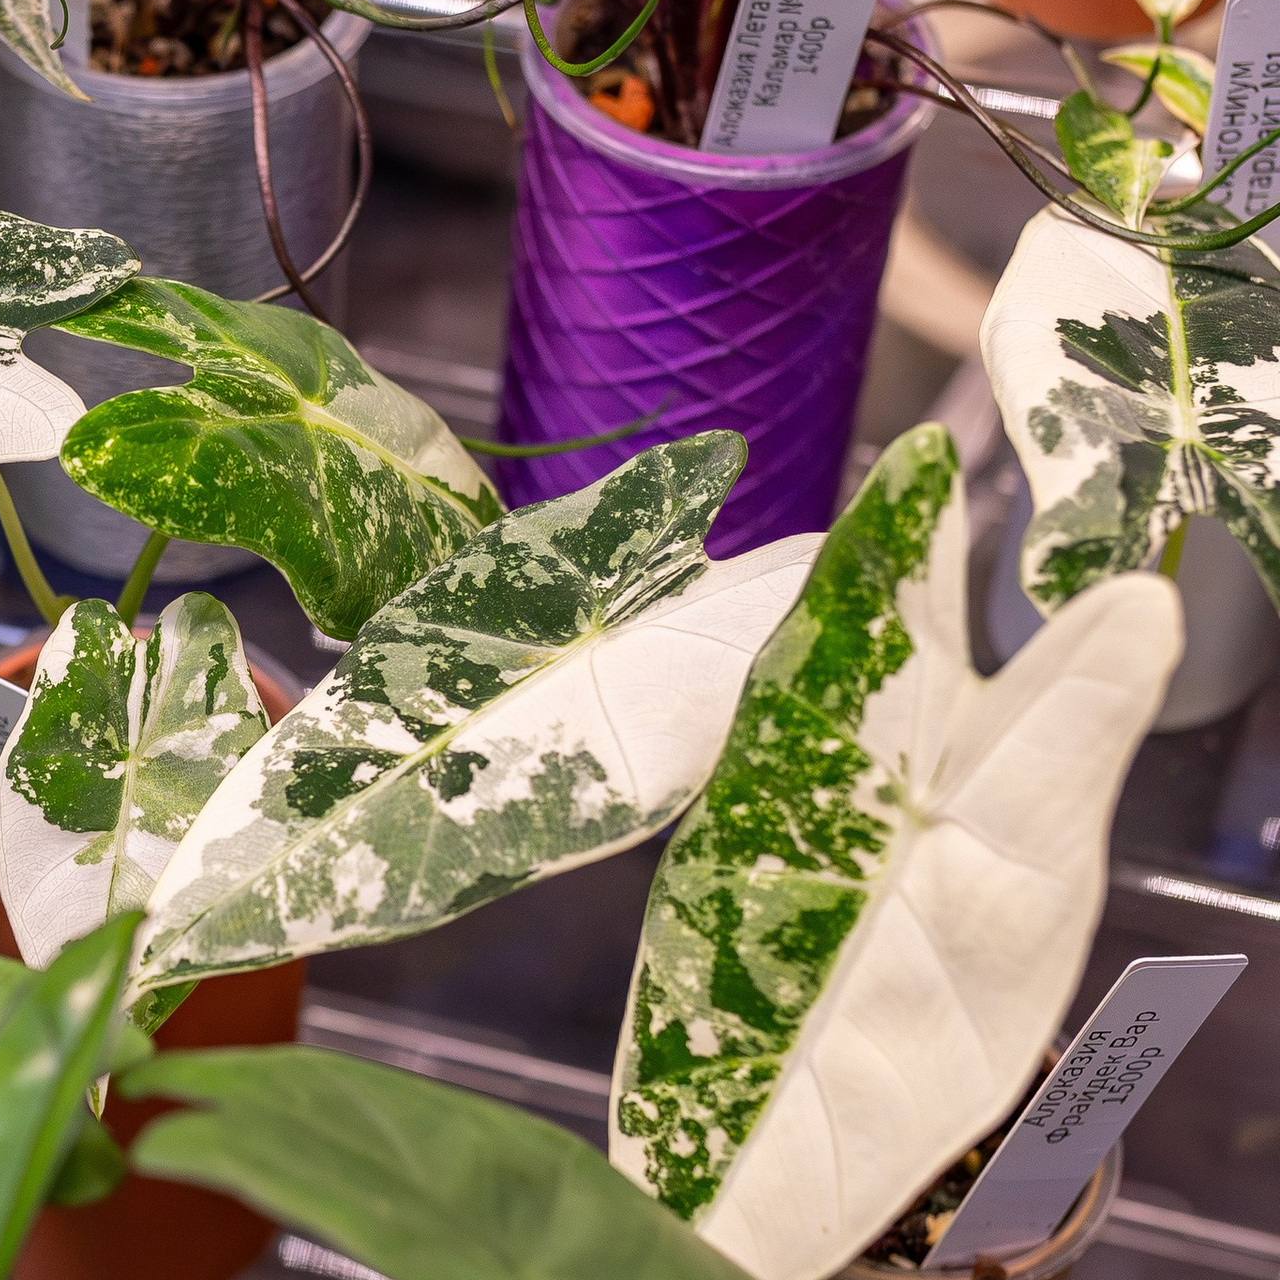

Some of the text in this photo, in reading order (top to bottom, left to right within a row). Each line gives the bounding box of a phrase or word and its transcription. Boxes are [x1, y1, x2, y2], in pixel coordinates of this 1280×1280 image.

[752, 19, 801, 108] Кальмар
[791, 15, 835, 75] 1400р
[1022, 1030, 1112, 1128] Алоказия
[1045, 1011, 1160, 1144] Фрайдек Вар
[1101, 1047, 1165, 1105] 1500р
